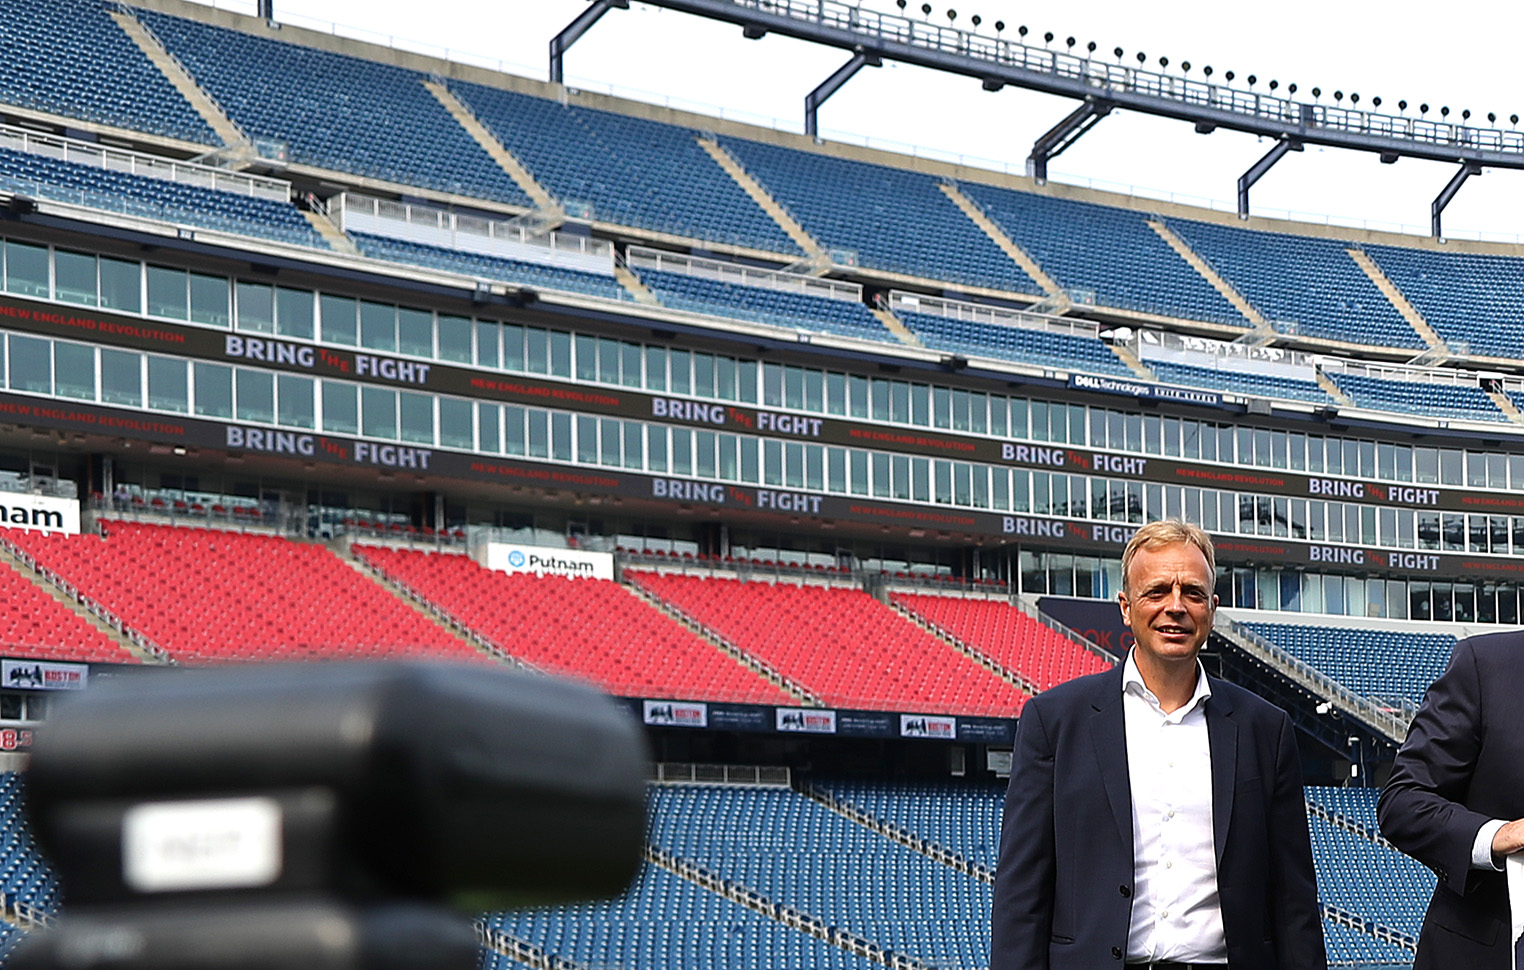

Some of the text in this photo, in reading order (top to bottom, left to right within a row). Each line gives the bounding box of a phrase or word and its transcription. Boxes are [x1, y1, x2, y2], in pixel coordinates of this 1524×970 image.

[0, 306, 185, 343] NEW ENGLAND REVOLUTION
[225, 335, 431, 384] BRING THE FIGHT
[0, 404, 184, 435] NEW ENGLAND REVOLUTION
[652, 397, 725, 424] BRING
[757, 412, 823, 436] FIGHT
[226, 426, 431, 469] BRING THE FIGHT
[1002, 443, 1064, 466] BRING
[1093, 454, 1147, 475] FIGHT
[653, 478, 725, 503] BRING
[757, 490, 823, 513] FIGHT
[1309, 478, 1364, 498] BRING
[1388, 486, 1440, 505] FIGHT
[1003, 516, 1064, 537] BRING
[1093, 525, 1136, 543] FIGH
[529, 554, 594, 571] Putnam
[1309, 546, 1364, 564] BRING
[1389, 552, 1440, 570] FIGHT
